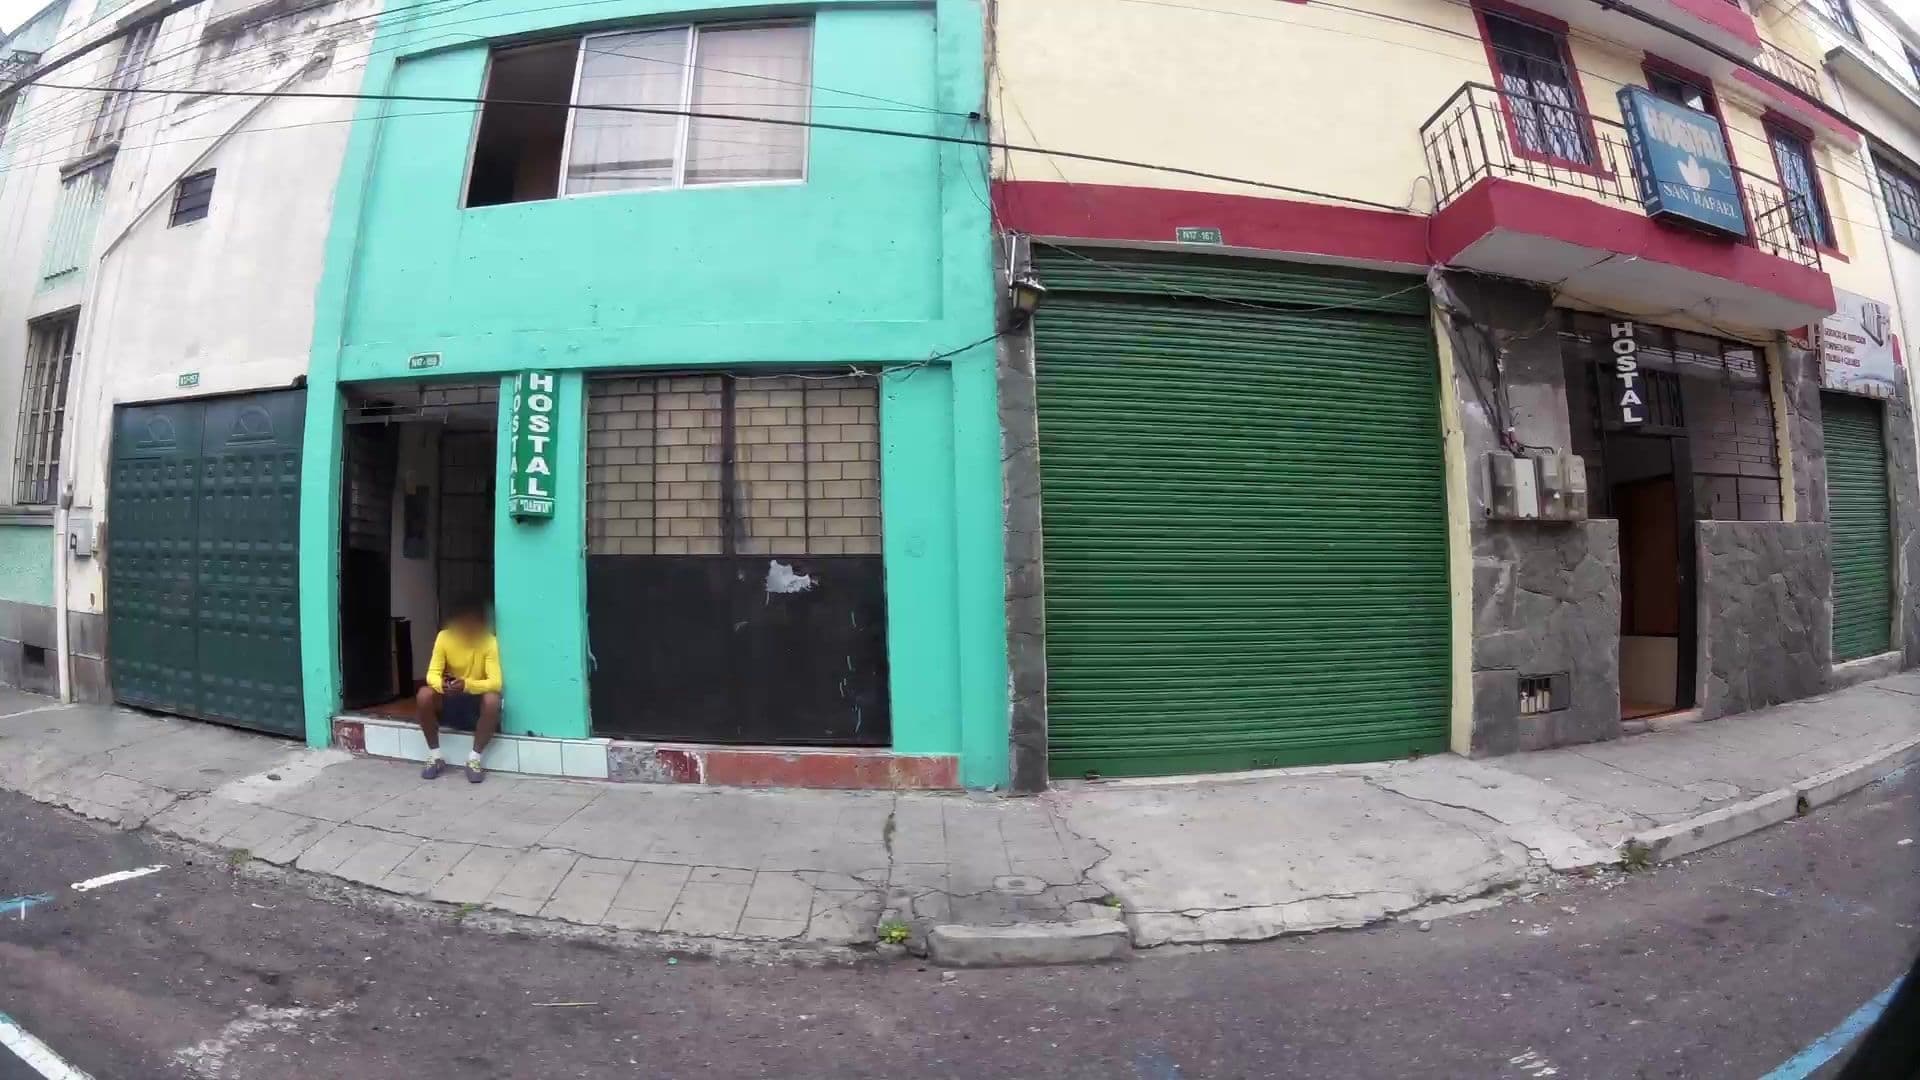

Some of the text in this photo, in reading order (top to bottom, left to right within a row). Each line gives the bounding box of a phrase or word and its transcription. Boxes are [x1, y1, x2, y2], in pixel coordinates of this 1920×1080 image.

[1662, 184, 1738, 219] SAN RAFAEL
[1610, 321, 1643, 423] HOSTAL
[509, 373, 522, 495] HOSTAL
[525, 372, 553, 497] HOSTAL
